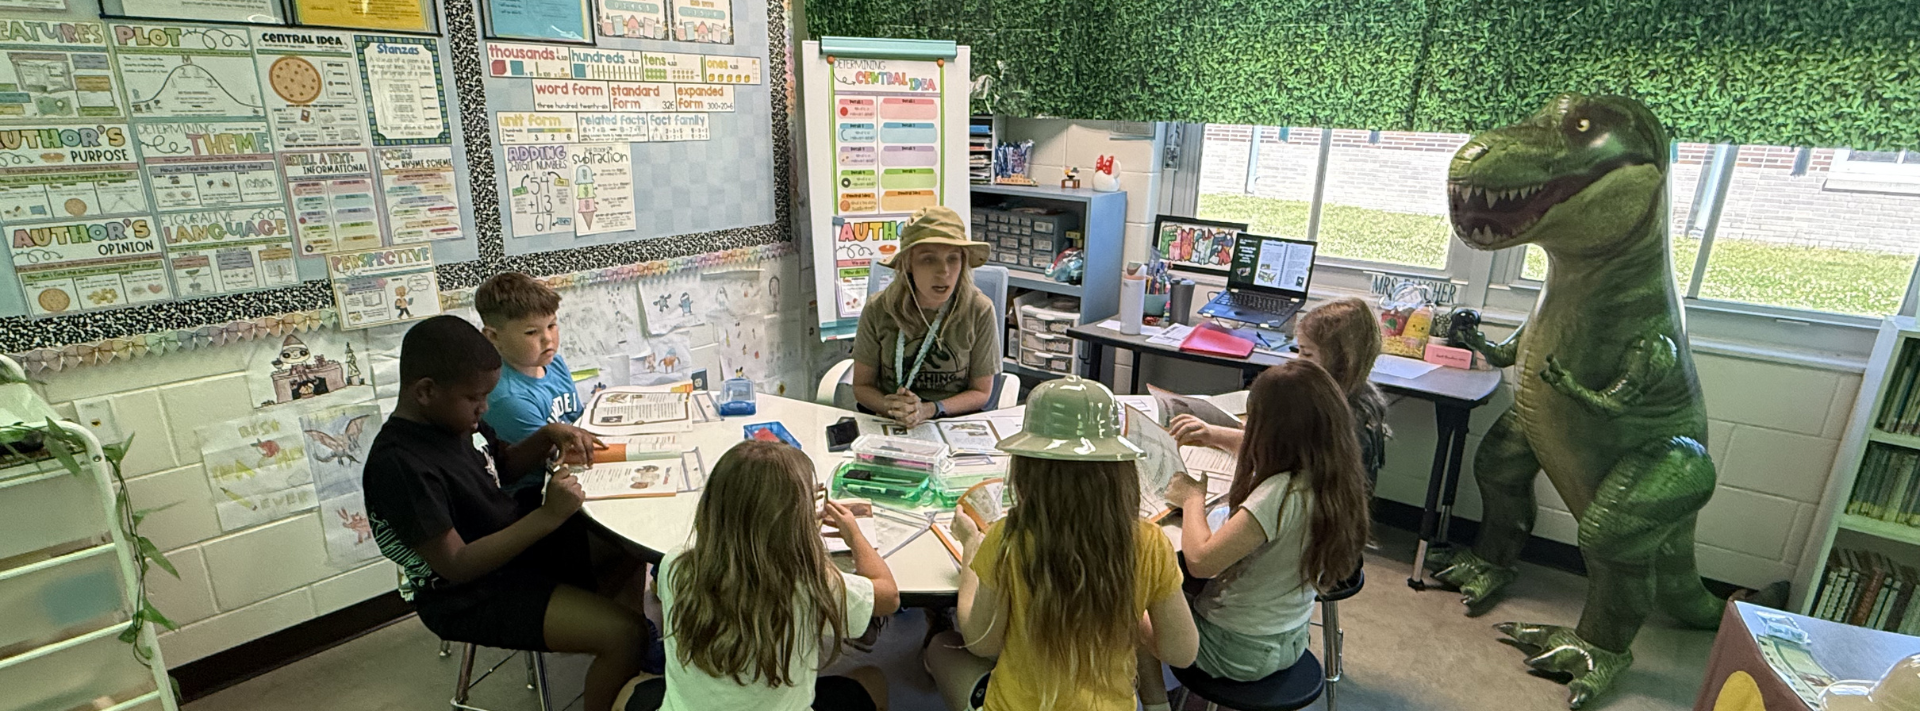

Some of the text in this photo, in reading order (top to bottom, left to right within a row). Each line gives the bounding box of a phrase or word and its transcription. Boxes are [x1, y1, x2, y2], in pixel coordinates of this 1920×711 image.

[114, 25, 182, 47] PLOT
[376, 43, 420, 55] Stanzas
[489, 44, 555, 60] thousands
[572, 50, 625, 64] hundreds
[644, 53, 666, 66] tens
[707, 60, 728, 70] ones
[834, 60, 886, 70] DETERMINING
[855, 71, 936, 92] CENTRAL IDEA
[535, 83, 603, 96] word form
[611, 85, 660, 96] standard
[677, 86, 724, 98] expanded
[612, 98, 641, 109] form
[678, 98, 703, 109] form
[500, 114, 561, 126] unit form
[580, 115, 645, 126] related facts
[650, 114, 705, 127] fact family
[137, 123, 217, 135] DETERMINING
[0, 124, 126, 150] UTHOR'S
[186, 132, 270, 156] THEME
[70, 149, 129, 163] PURPOSE
[319, 153, 327, 165] A
[508, 146, 566, 161] ADDING
[303, 164, 368, 174] INFORMATIONAL
[401, 158, 452, 168] RHYME SCHEME
[508, 160, 567, 172] 2-DIGIT NUMBERS
[530, 177, 550, 196] 54
[160, 212, 232, 226] FIGURATIVE
[535, 214, 552, 232] 67
[13, 218, 150, 248] AUTHOR'S
[163, 219, 287, 244] LANGUAGE
[98, 240, 154, 256] OPINION
[330, 247, 430, 272] PERSPECTIVE
